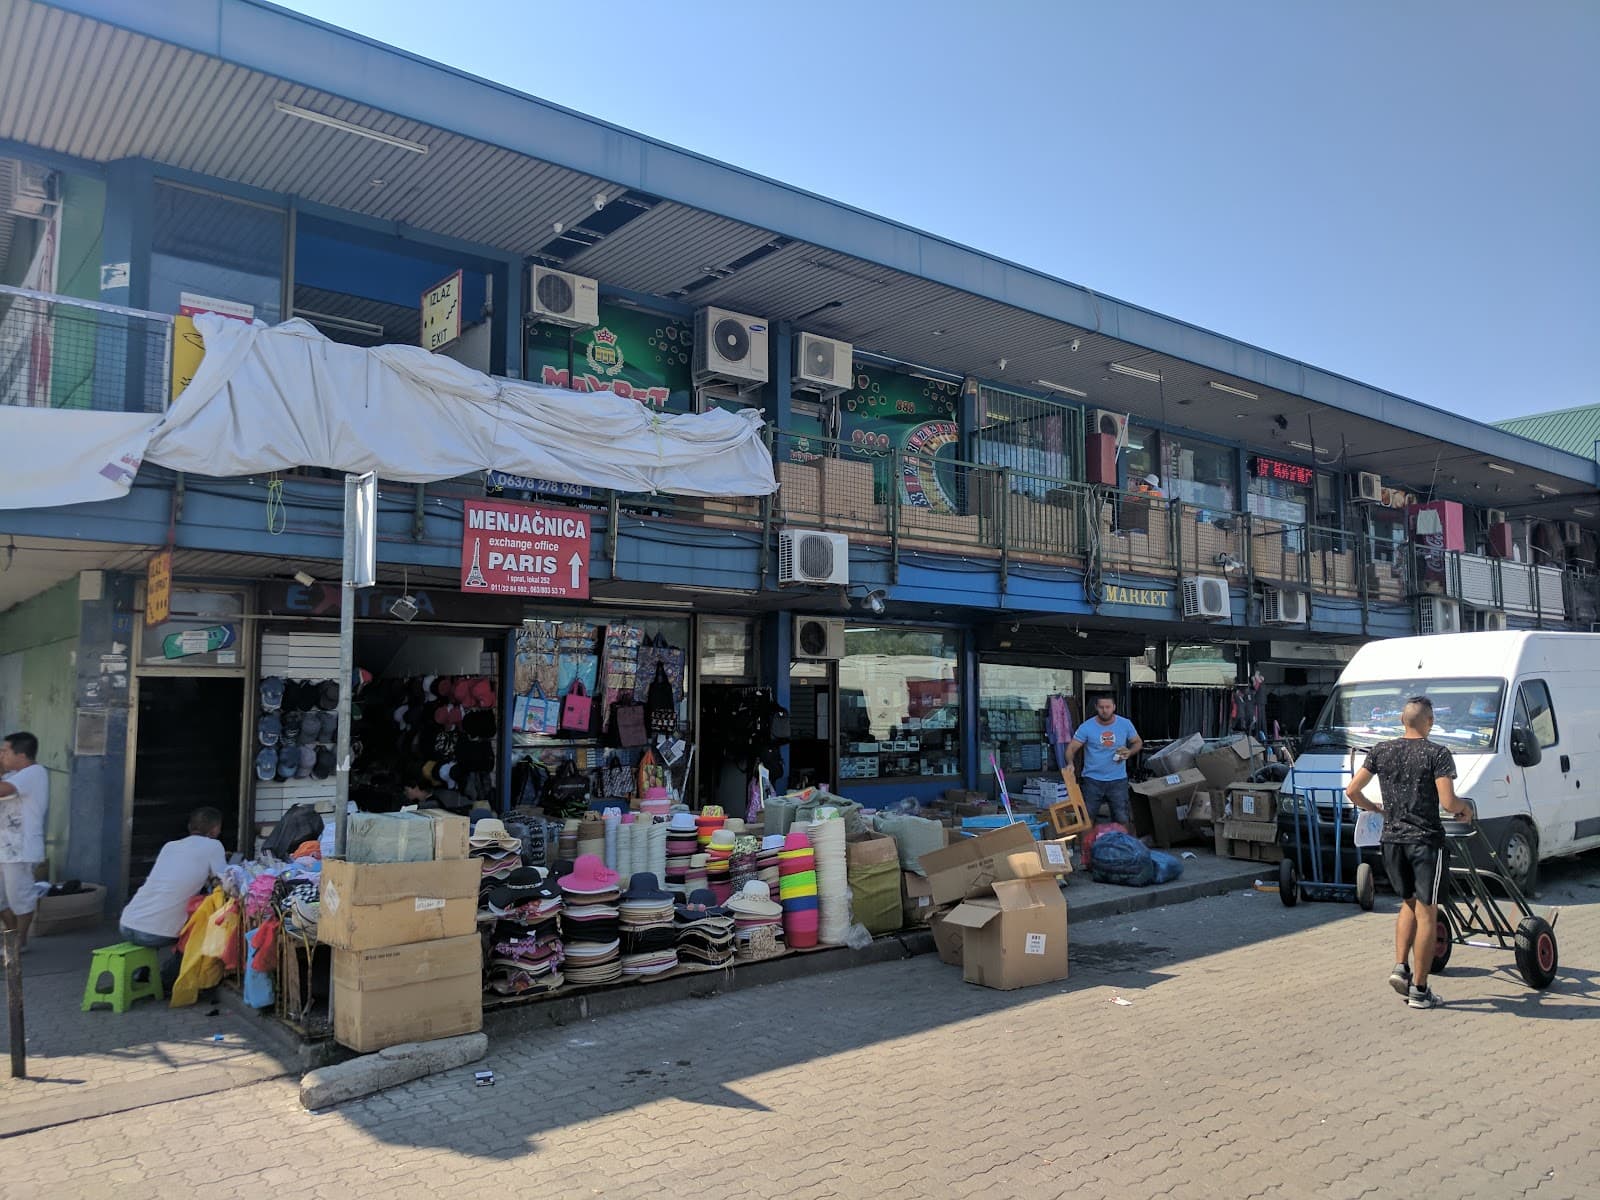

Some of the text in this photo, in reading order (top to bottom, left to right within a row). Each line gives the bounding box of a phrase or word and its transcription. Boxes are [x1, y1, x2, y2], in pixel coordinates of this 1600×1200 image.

[430, 284, 451, 306] IZLAZ
[431, 328, 448, 347] EXIT
[498, 474, 583, 496] 063/8 278 968
[469, 509, 586, 539] MENJAČNICA
[488, 537, 559, 551] exchange office
[488, 551, 558, 575] PARIS
[1105, 584, 1169, 607] MARKET
